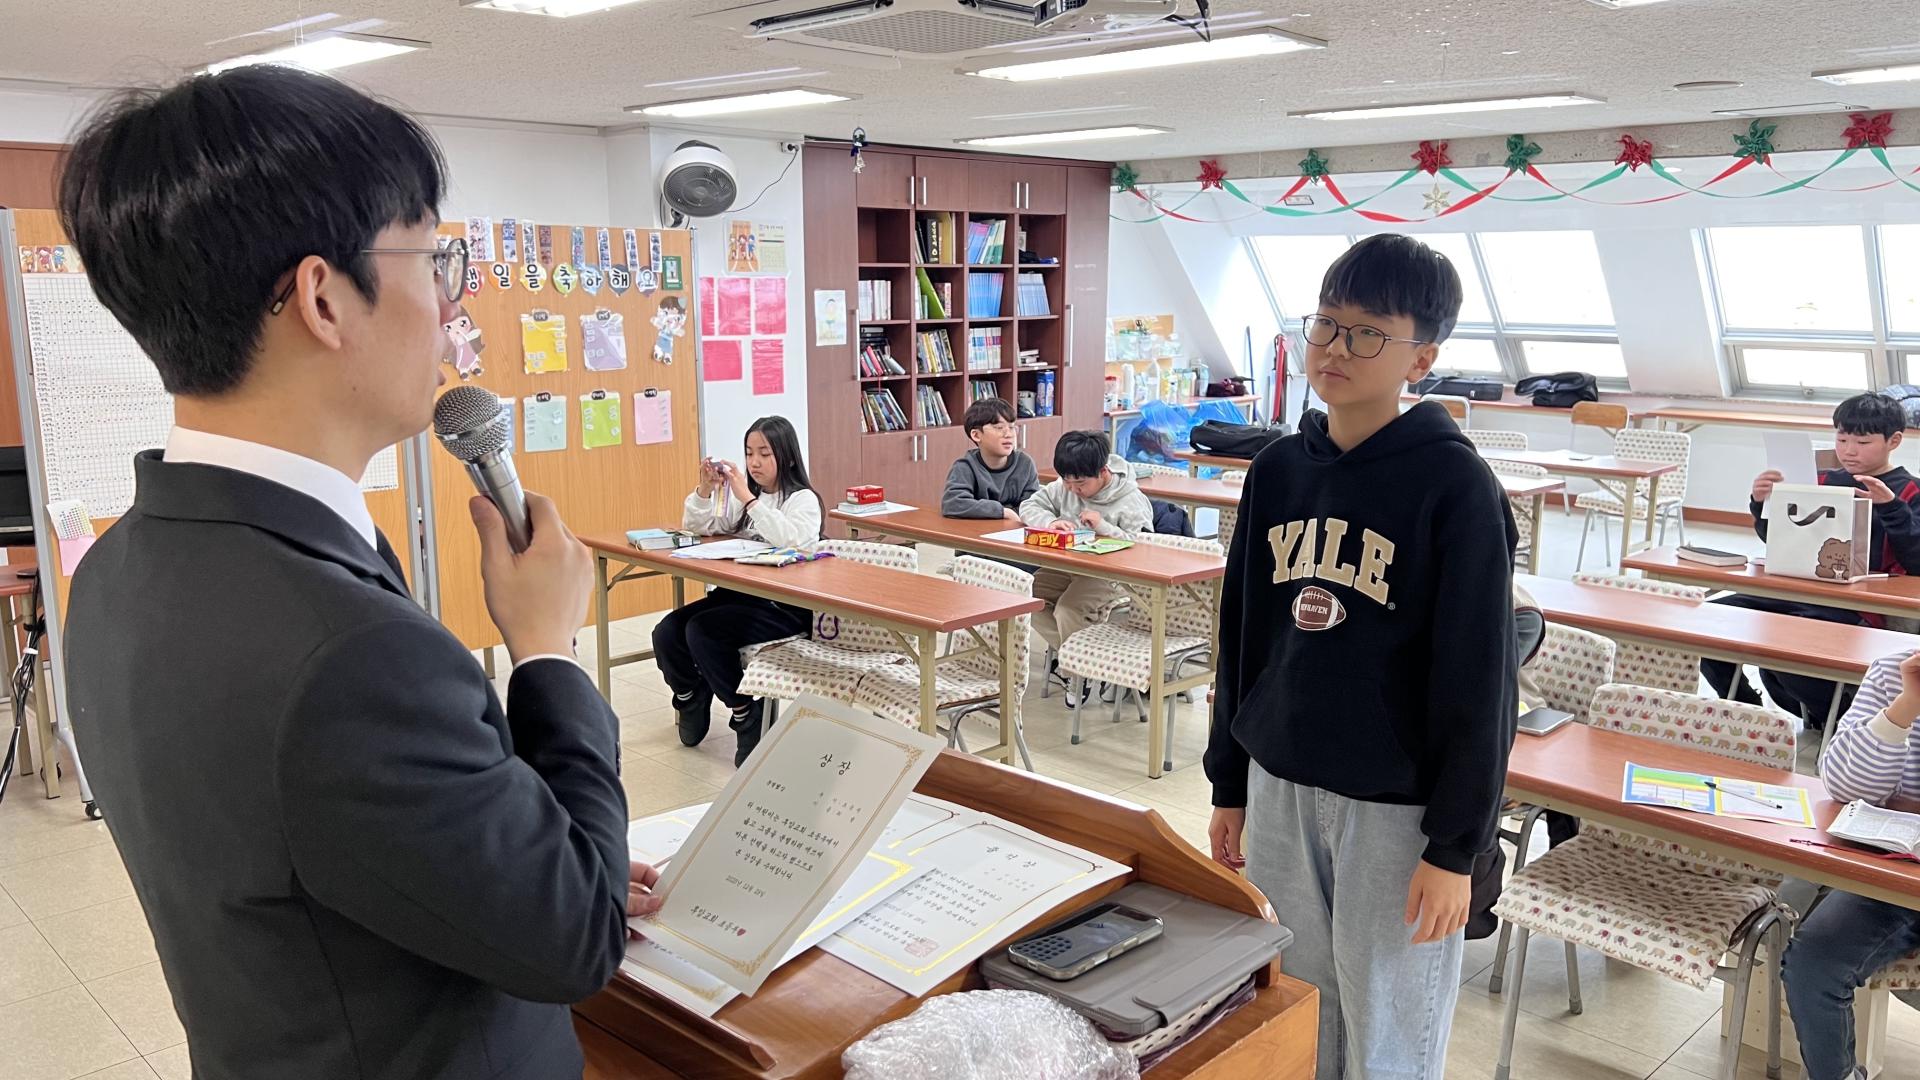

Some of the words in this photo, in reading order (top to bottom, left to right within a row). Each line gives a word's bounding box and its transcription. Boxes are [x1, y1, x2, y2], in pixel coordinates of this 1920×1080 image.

[465, 263, 542, 293] 생일을
[1267, 517, 1396, 606] YALE
[820, 753, 833, 768] 상
[837, 760, 852, 776] 장
[756, 805, 780, 823] 어린이는
[735, 830, 748, 841] 바른
[750, 836, 768, 852] 선택을
[744, 852, 762, 867] 상장을
[763, 862, 793, 881] 수여합니다.
